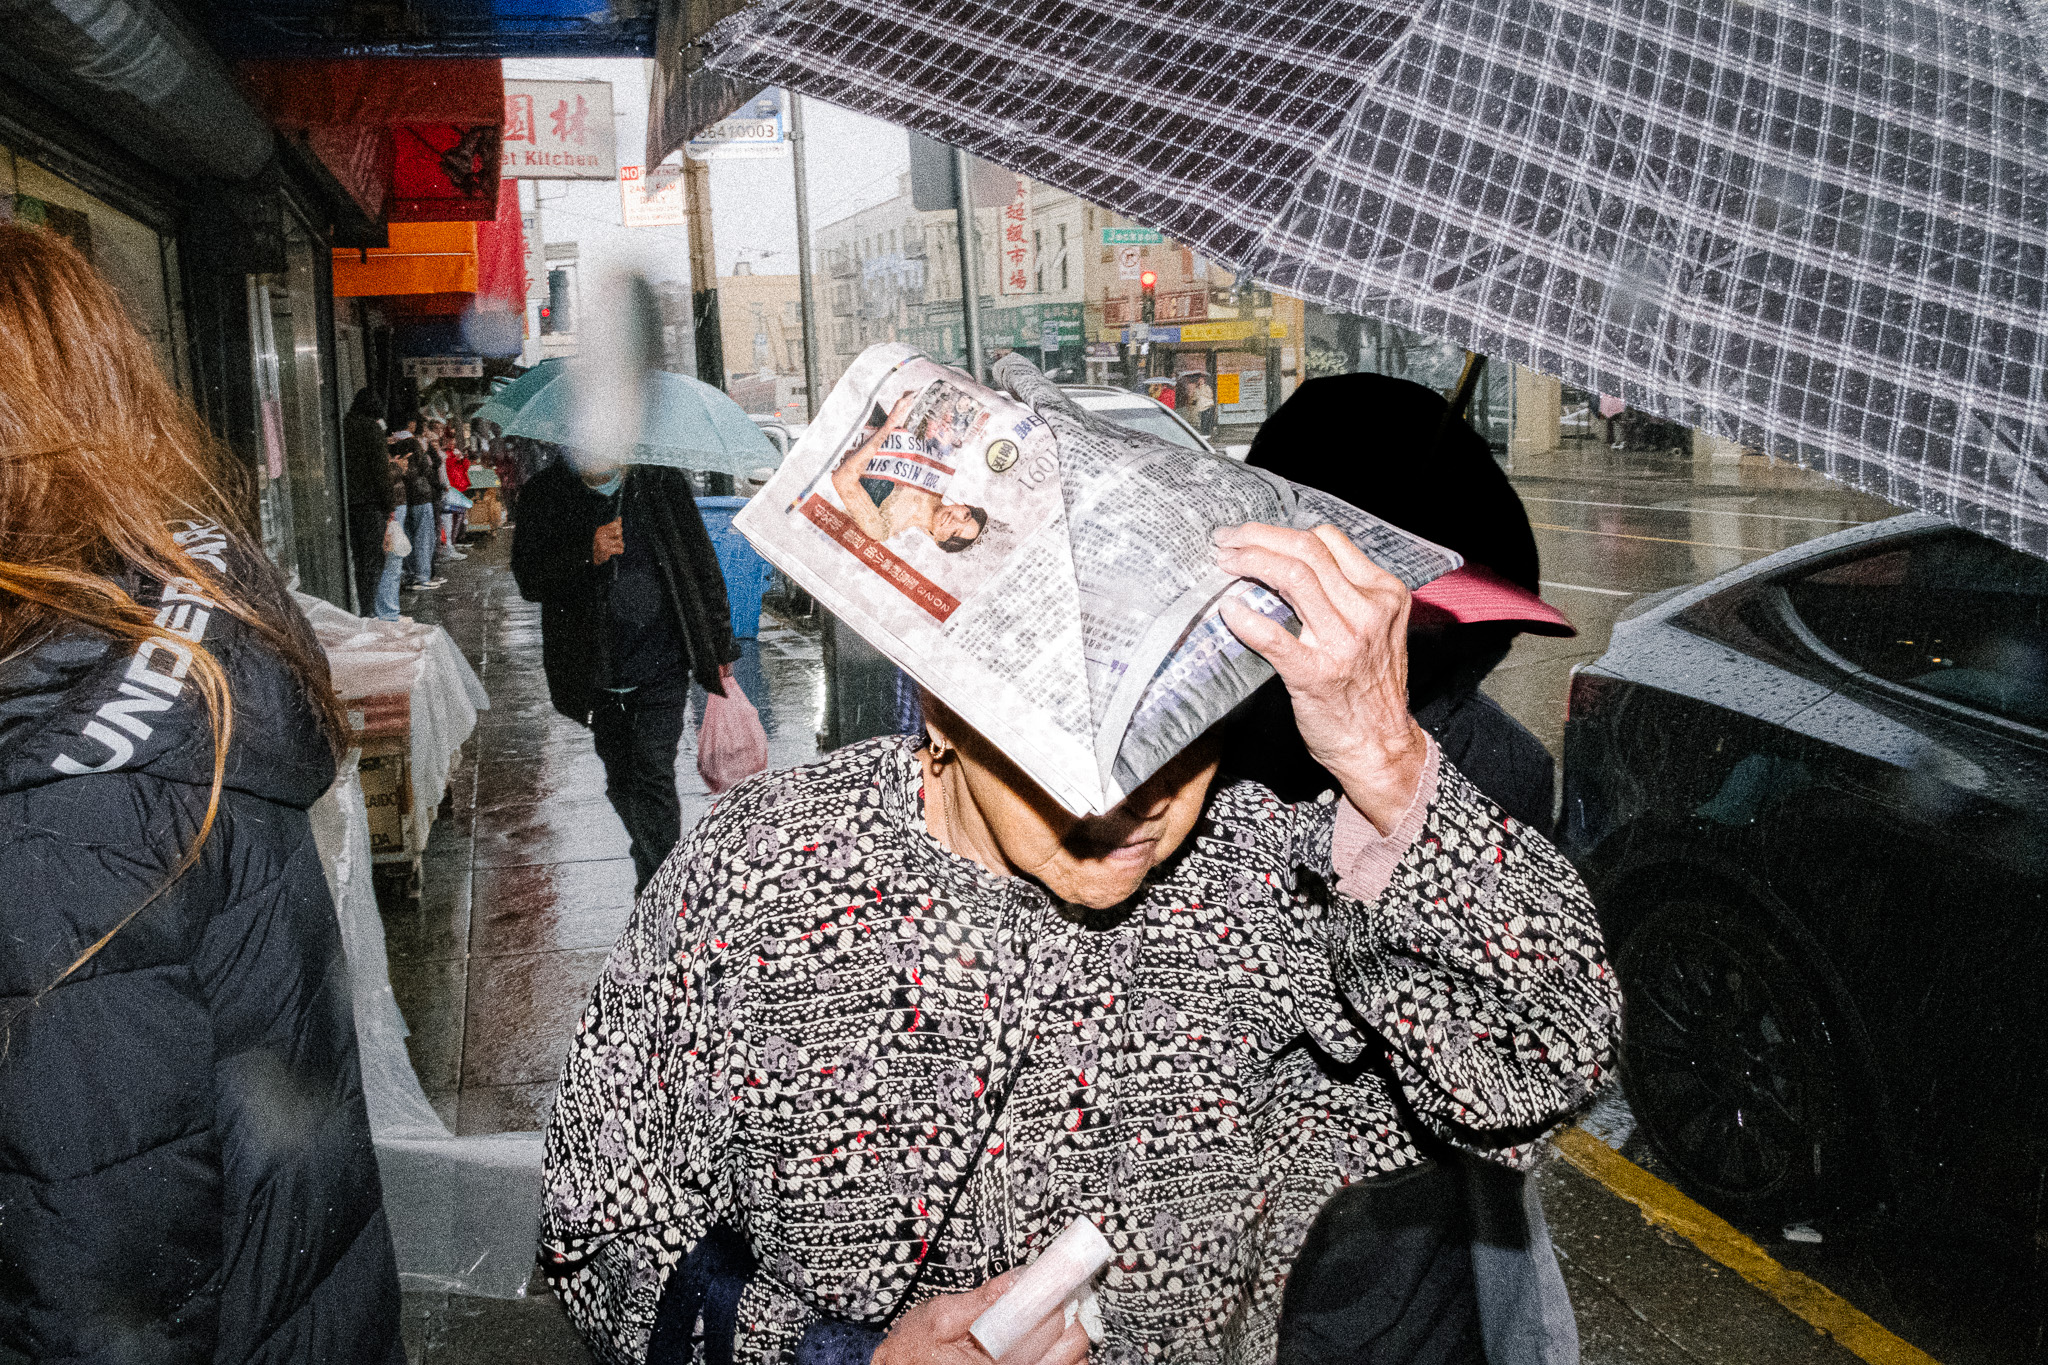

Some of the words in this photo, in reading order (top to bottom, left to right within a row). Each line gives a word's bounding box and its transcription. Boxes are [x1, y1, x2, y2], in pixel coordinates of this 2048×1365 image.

[525, 150, 598, 166] Kitchen
[620, 168, 638, 181] NO
[1109, 229, 1159, 242] Jackson
[916, 586, 951, 613] 2023
